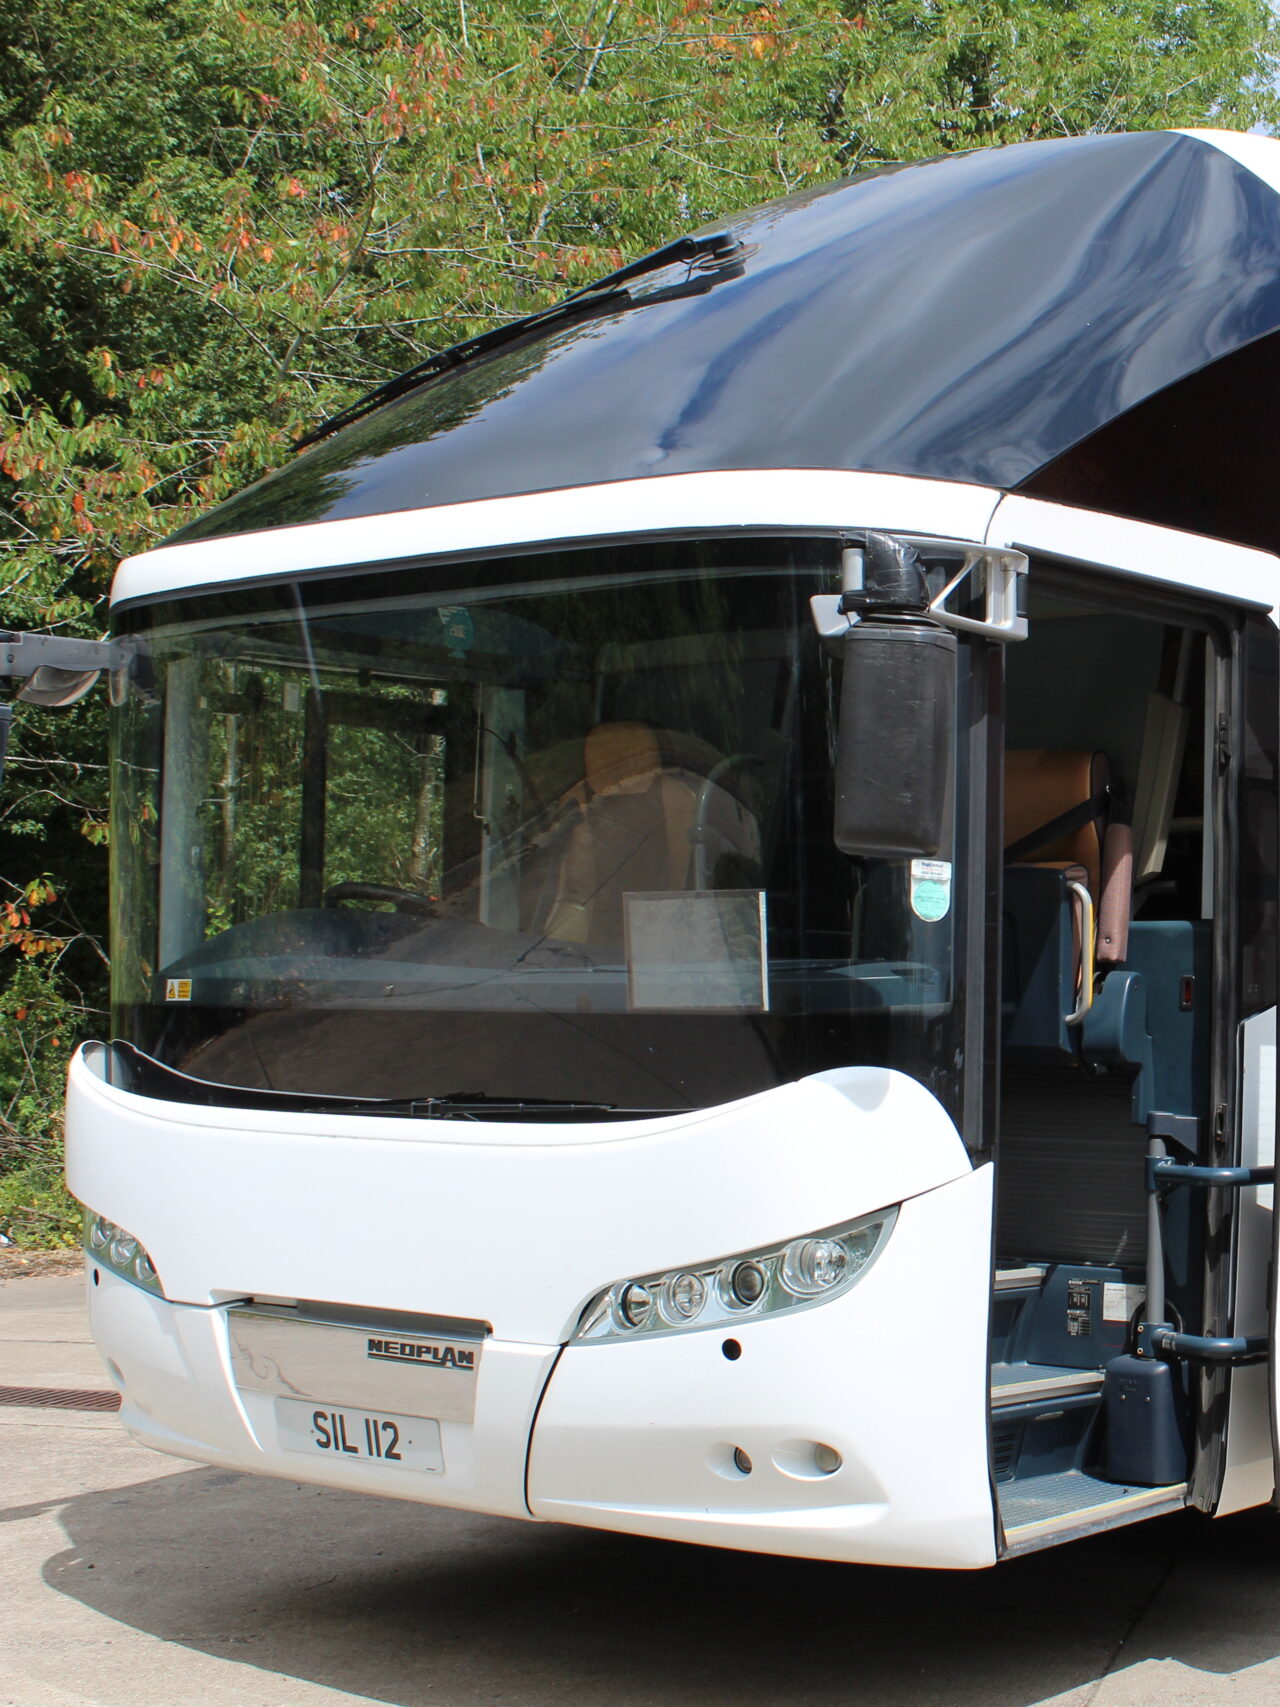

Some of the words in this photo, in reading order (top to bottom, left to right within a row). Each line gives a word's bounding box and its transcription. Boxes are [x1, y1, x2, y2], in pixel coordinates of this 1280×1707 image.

[367, 1337, 474, 1369] NEOPLAN
[312, 1410, 359, 1454] SIL
[364, 1417, 402, 1461] 112
